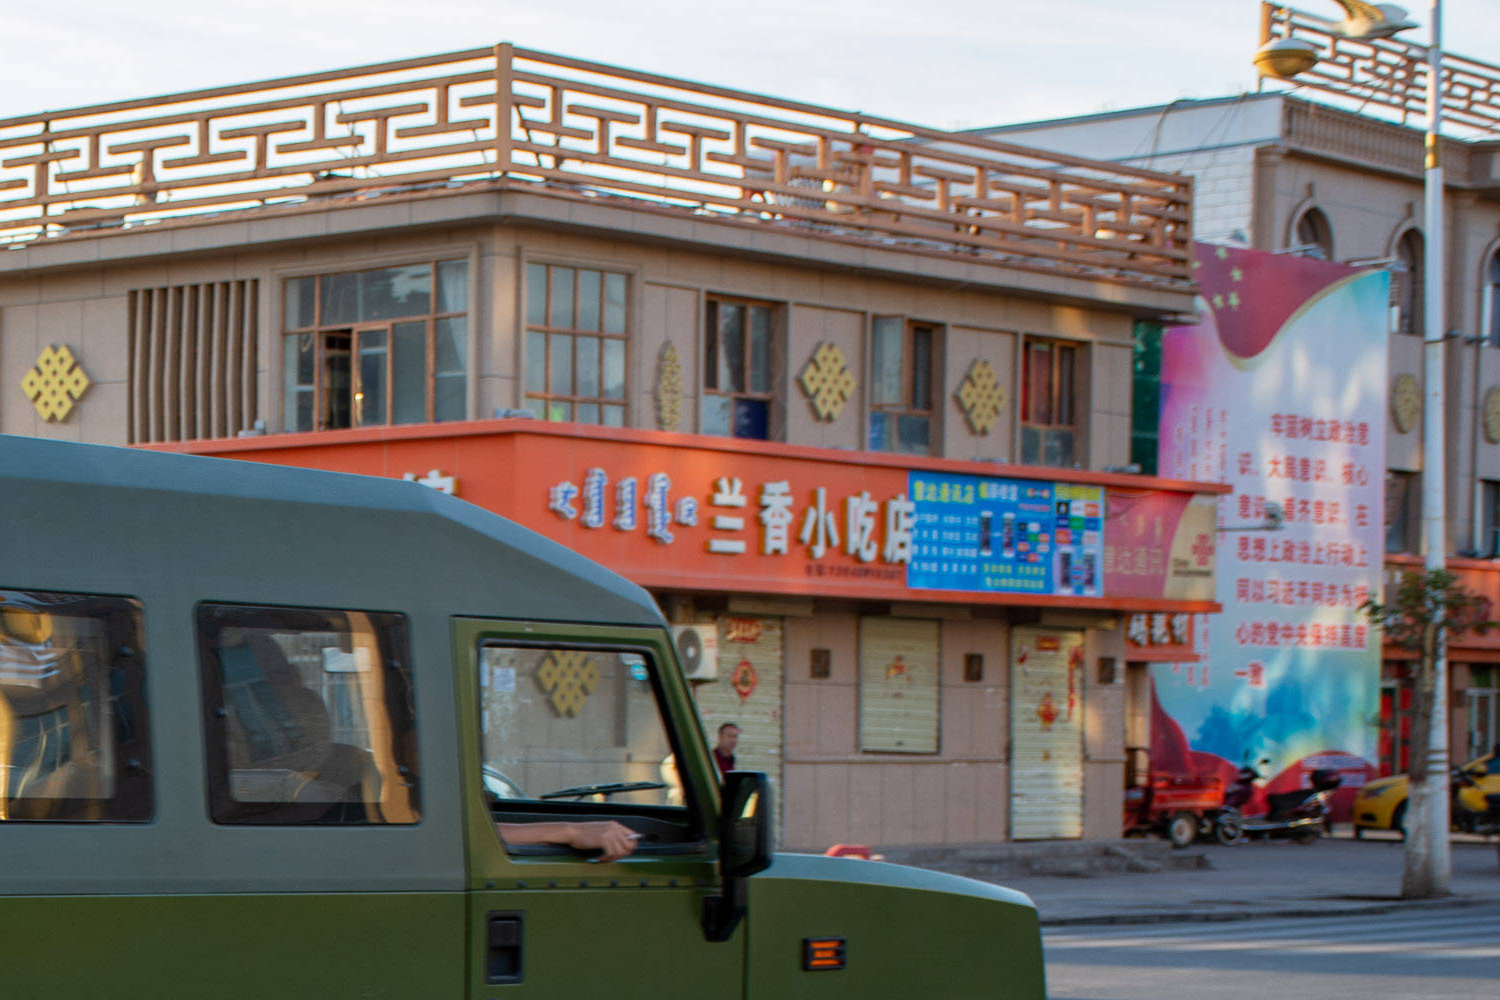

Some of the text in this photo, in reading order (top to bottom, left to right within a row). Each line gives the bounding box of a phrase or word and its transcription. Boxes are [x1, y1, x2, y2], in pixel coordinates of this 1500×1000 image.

[708, 477, 914, 564] 兰香小吃店
